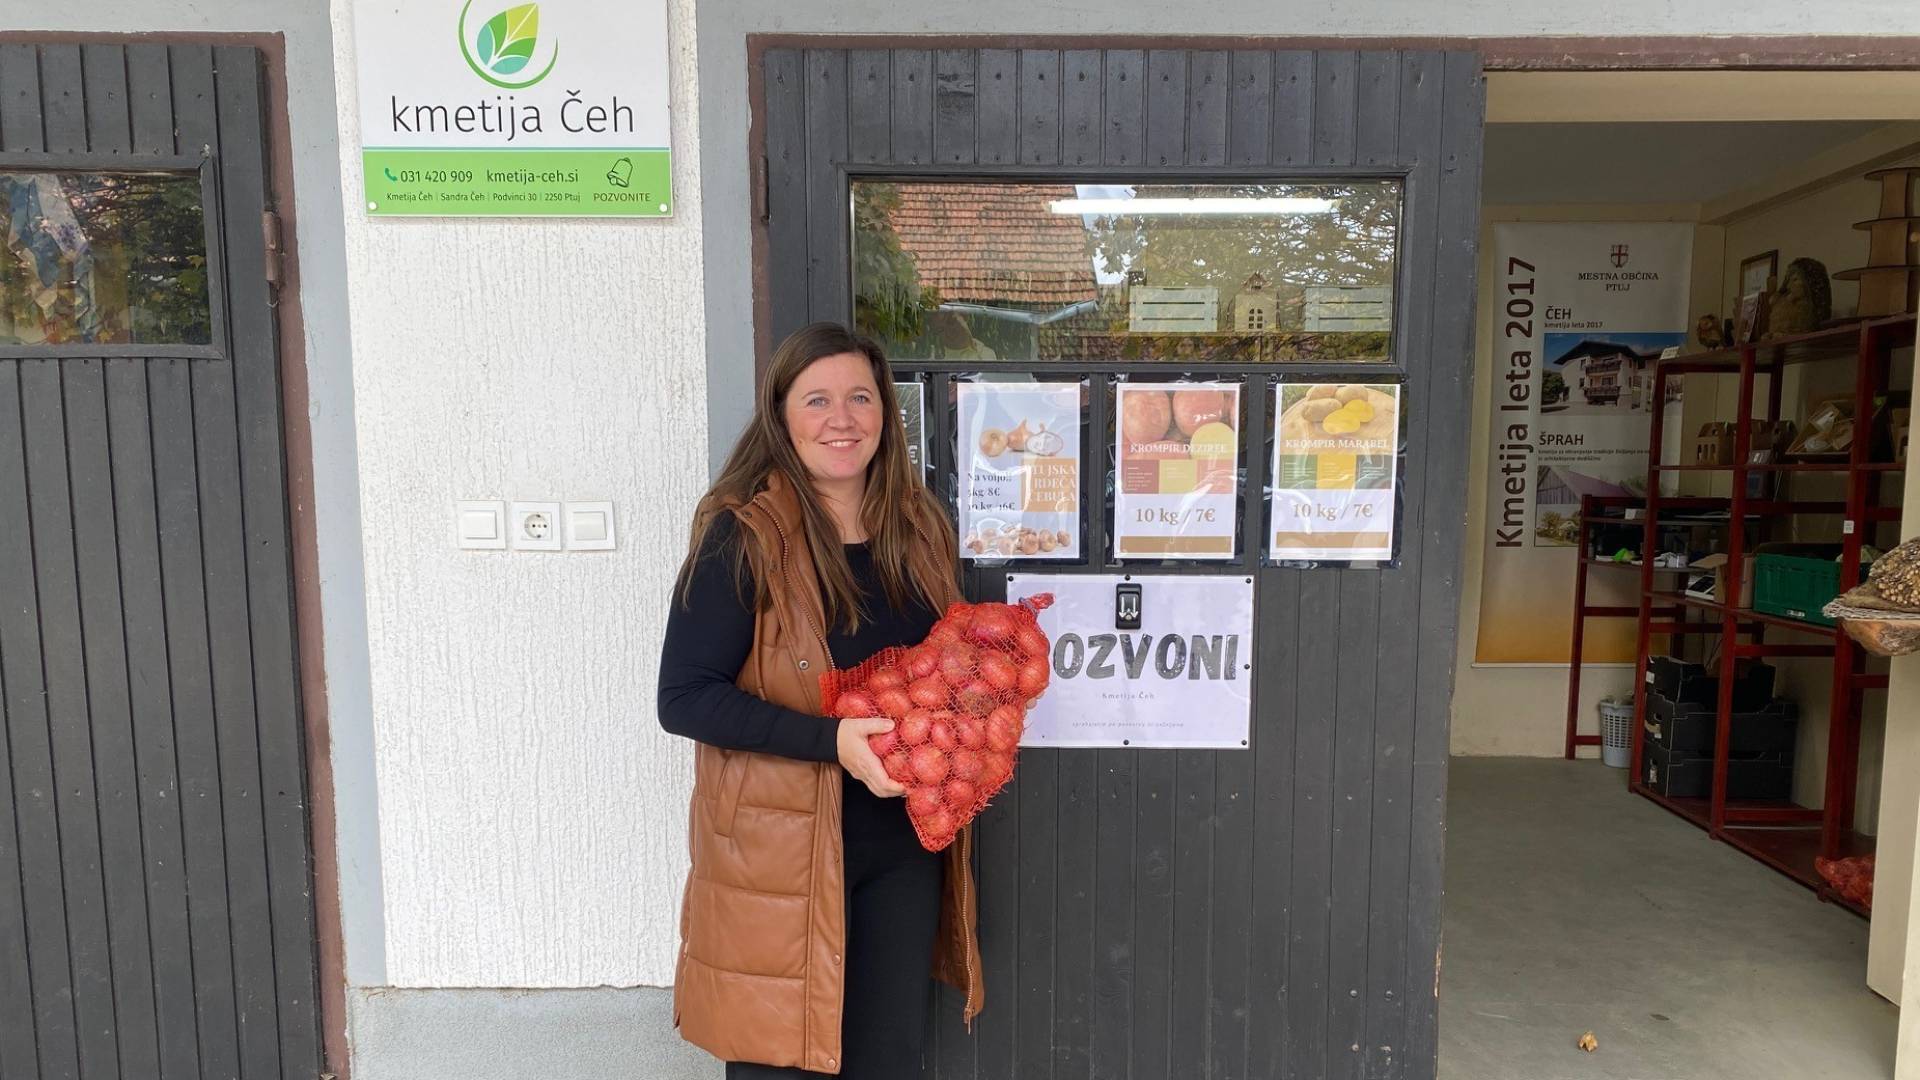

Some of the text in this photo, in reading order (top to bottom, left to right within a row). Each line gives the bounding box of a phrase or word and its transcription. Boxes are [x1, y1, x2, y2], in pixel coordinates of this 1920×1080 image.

[391, 89, 634, 142] kmetija Čeh
[400, 169, 579, 185] 031 420 909 kmetija-ceh.si
[387, 191, 581, 203] Kmetija Čeh Sandra Čeh Podvinci 30 2250 Ptuj
[593, 192, 651, 202] POZVONITE
[1578, 271, 1659, 280] MESTNA OBČINA
[1605, 283, 1630, 292] PTUJ
[1545, 305, 1572, 320] ČEH
[1496, 256, 1536, 548] Kmetija leta 2017
[1285, 439, 1389, 449] KROMPIR MARABEL
[1539, 431, 1584, 446] ŠPRAH
[1130, 443, 1180, 453] KROMPIR
[1026, 464, 1076, 477] TUJSKA
[988, 488, 1001, 497] 8€
[1136, 507, 1216, 526] 10 kg / 7€
[1294, 503, 1373, 521] 10 kg / 7€
[1052, 632, 1239, 681] OZVONI
[1138, 691, 1155, 700] Čeh
